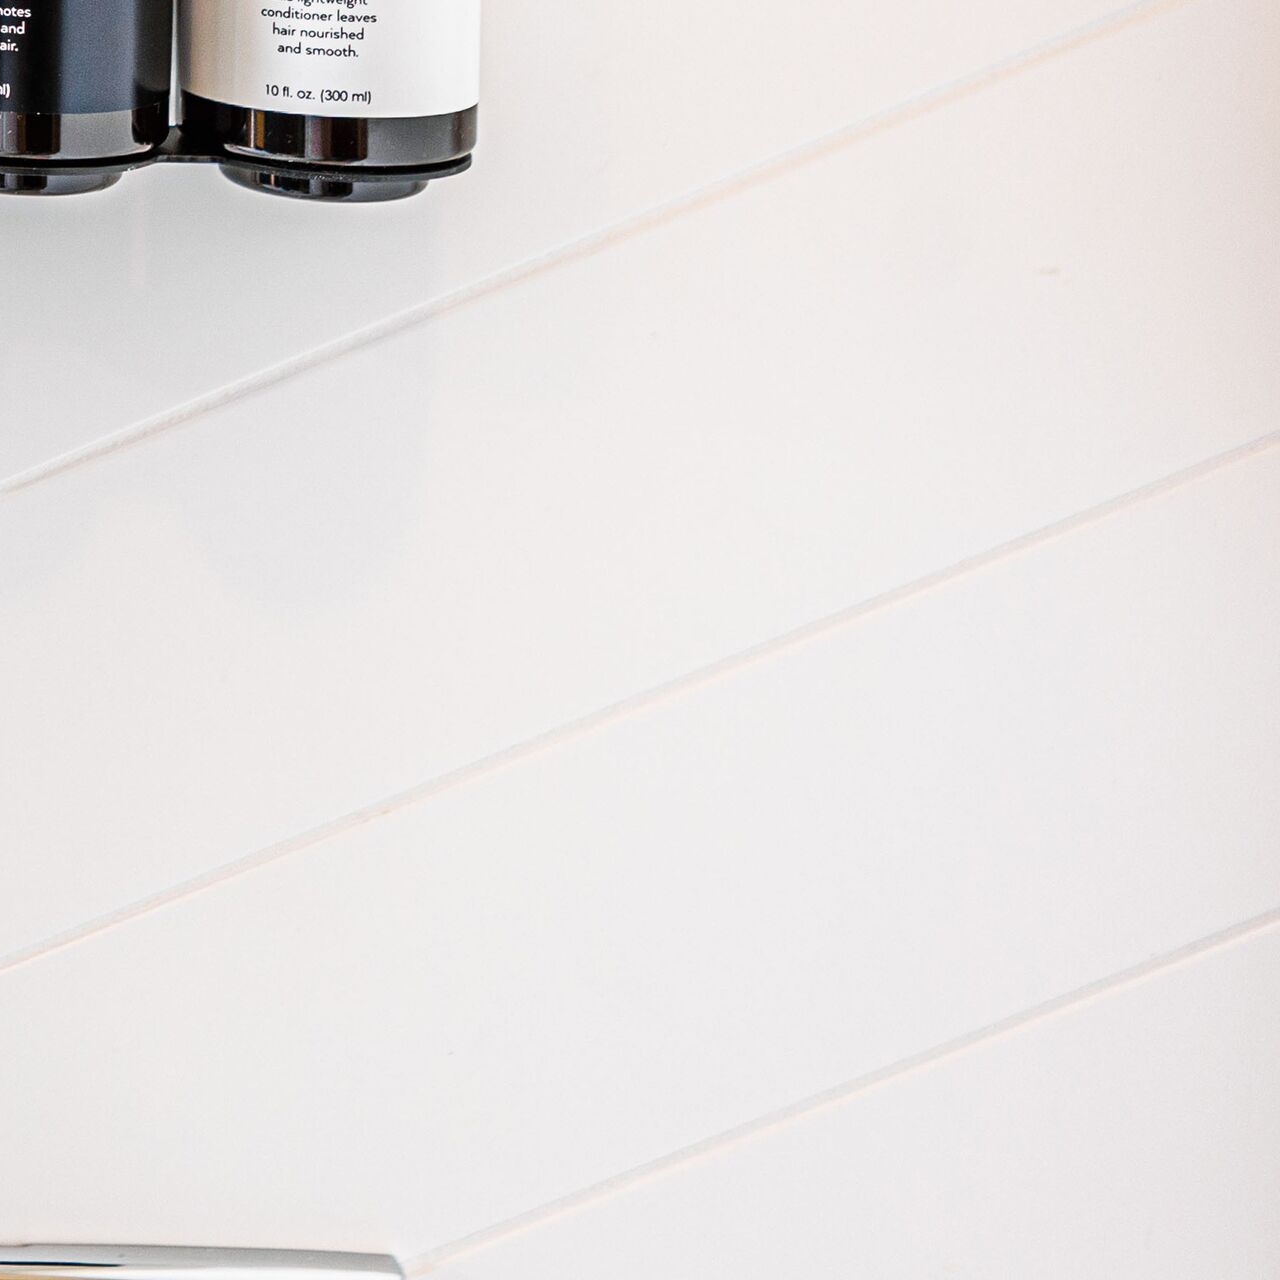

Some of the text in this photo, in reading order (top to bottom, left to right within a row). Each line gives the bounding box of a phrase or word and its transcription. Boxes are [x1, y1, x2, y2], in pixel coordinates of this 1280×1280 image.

[261, 7, 377, 23] conditioner leaves
[1, 20, 25, 34] and
[272, 23, 365, 40] hair nourished
[277, 42, 359, 58] and smooth.
[265, 84, 278, 96] 10
[297, 89, 315, 100] oz.
[320, 88, 348, 103] (300
[351, 89, 371, 104] ml)
